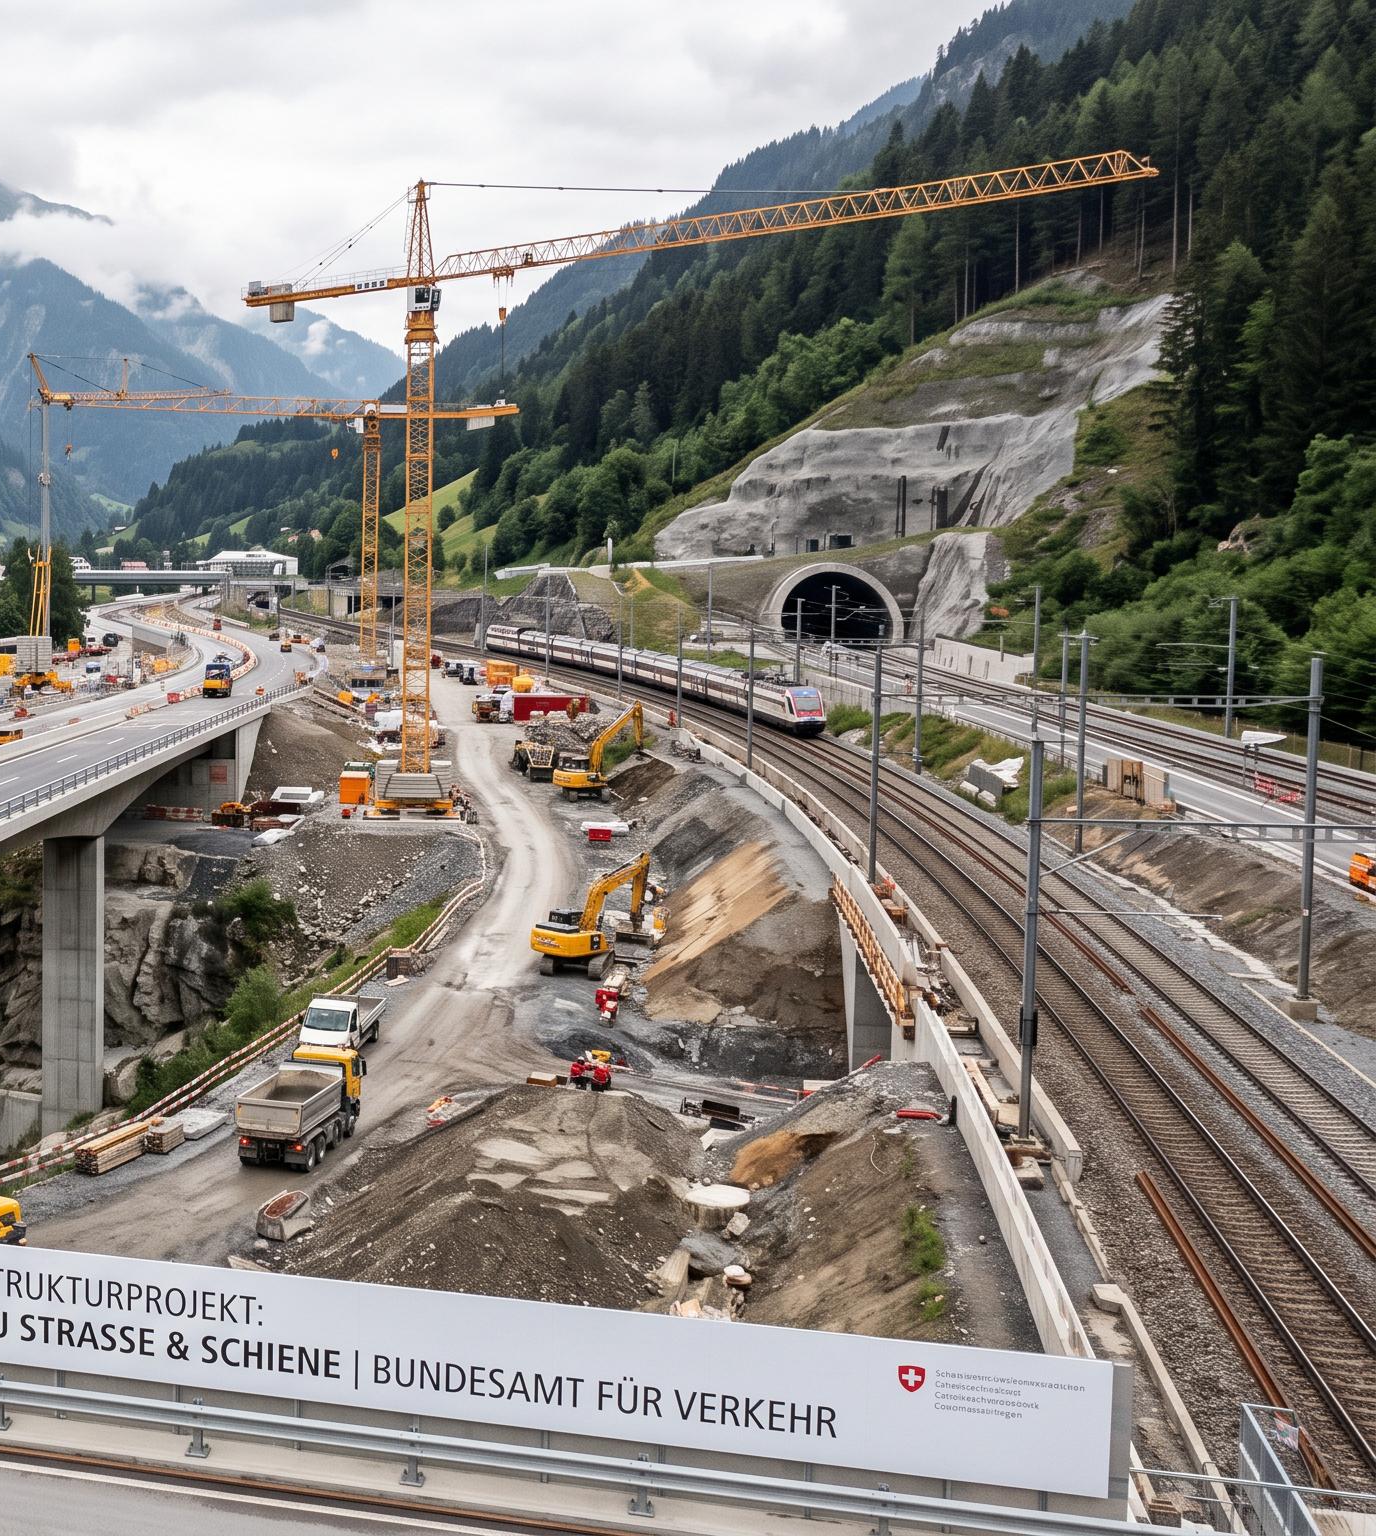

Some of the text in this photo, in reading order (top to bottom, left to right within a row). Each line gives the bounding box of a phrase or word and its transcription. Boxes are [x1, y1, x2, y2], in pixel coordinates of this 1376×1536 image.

[20, 1314, 155, 1357] STRASSE
[166, 1331, 190, 1361] &
[201, 1335, 341, 1380] SCHIENE
[373, 1354, 585, 1408] BUNDESAMT
[597, 1376, 663, 1418] FÜR
[673, 1389, 838, 1439] VERKEHR
